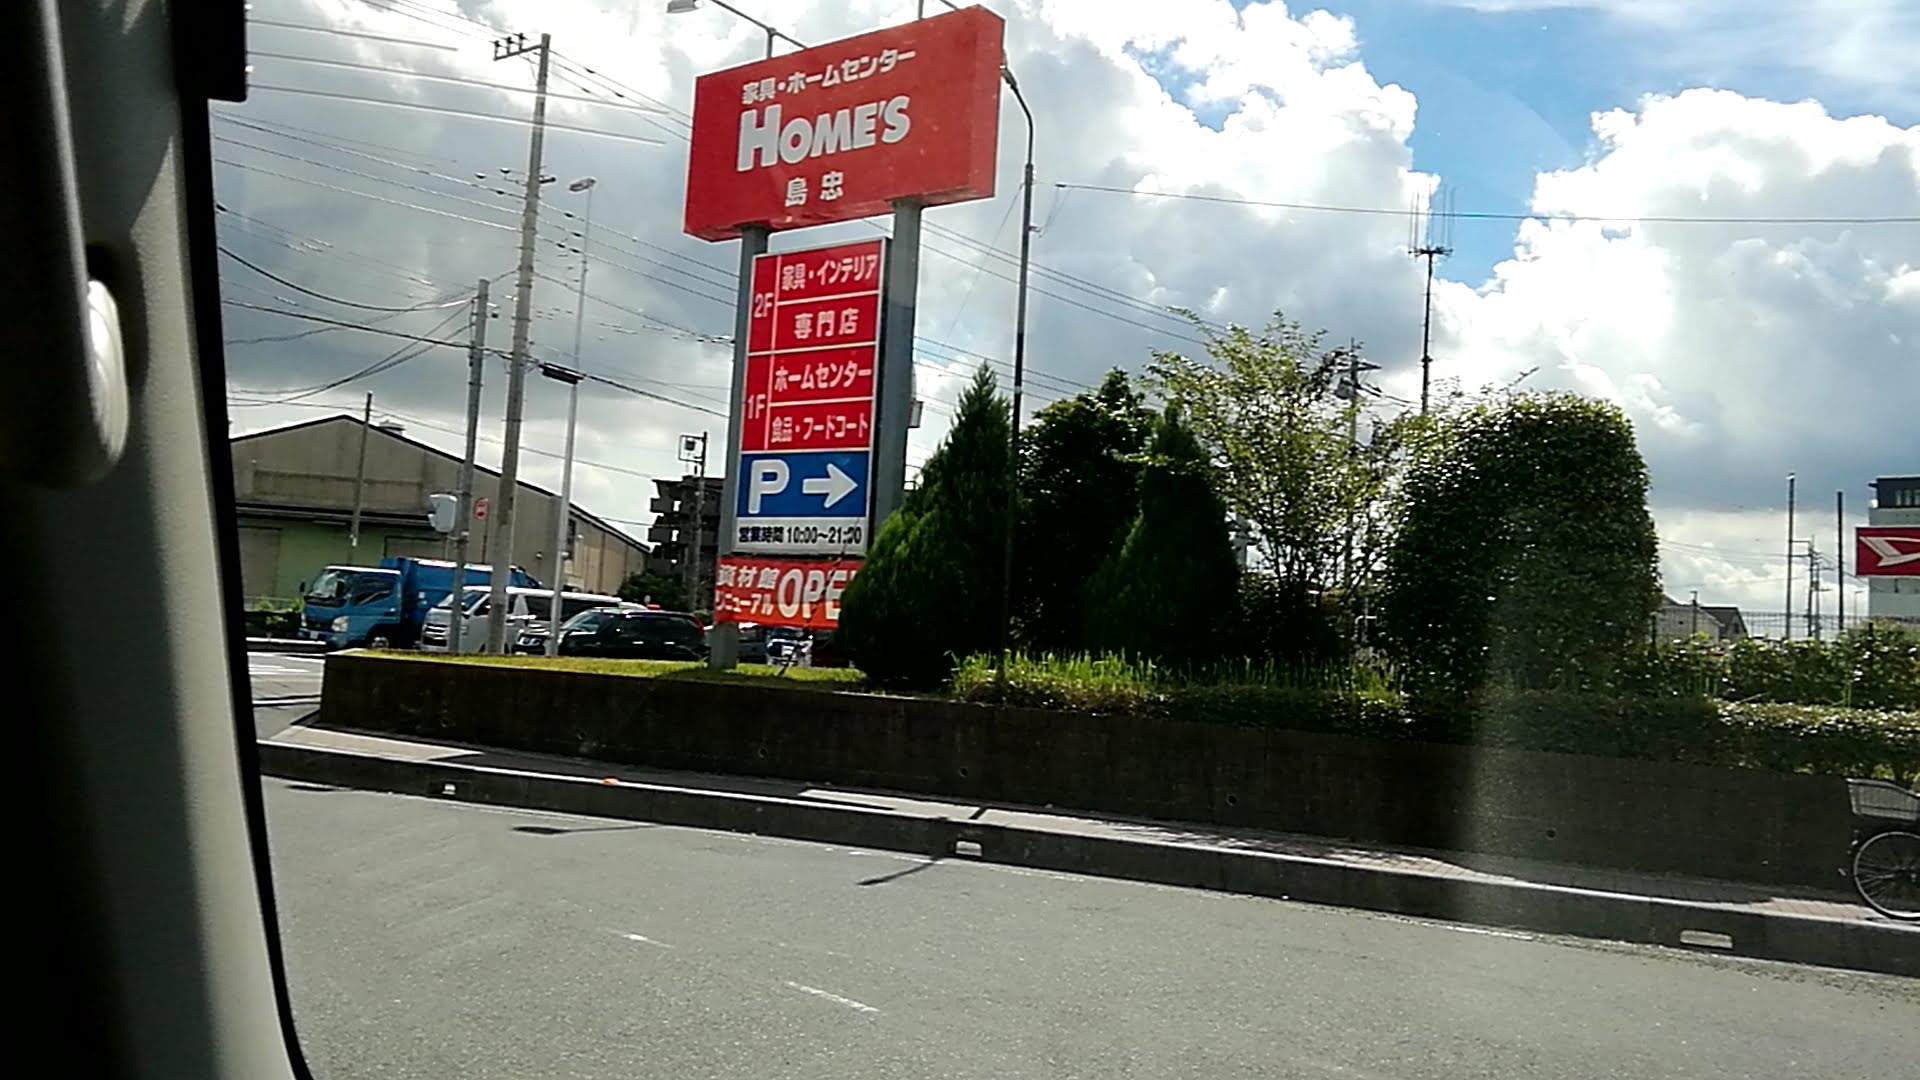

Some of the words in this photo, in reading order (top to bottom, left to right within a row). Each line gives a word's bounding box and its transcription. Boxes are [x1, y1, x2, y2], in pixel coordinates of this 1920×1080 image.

[742, 49, 916, 104] 家具・ホームセンター
[737, 95, 911, 172] HOME'S
[782, 254, 878, 290] 家具・インテリア
[754, 293, 773, 318] 2F
[794, 308, 859, 339] 専門店
[774, 360, 872, 392] ホームセンター
[747, 394, 766, 419] 1F
[771, 413, 868, 443] 食品・フードコート
[748, 459, 790, 514] P
[716, 564, 780, 590] 資材館
[777, 568, 858, 620] OPE
